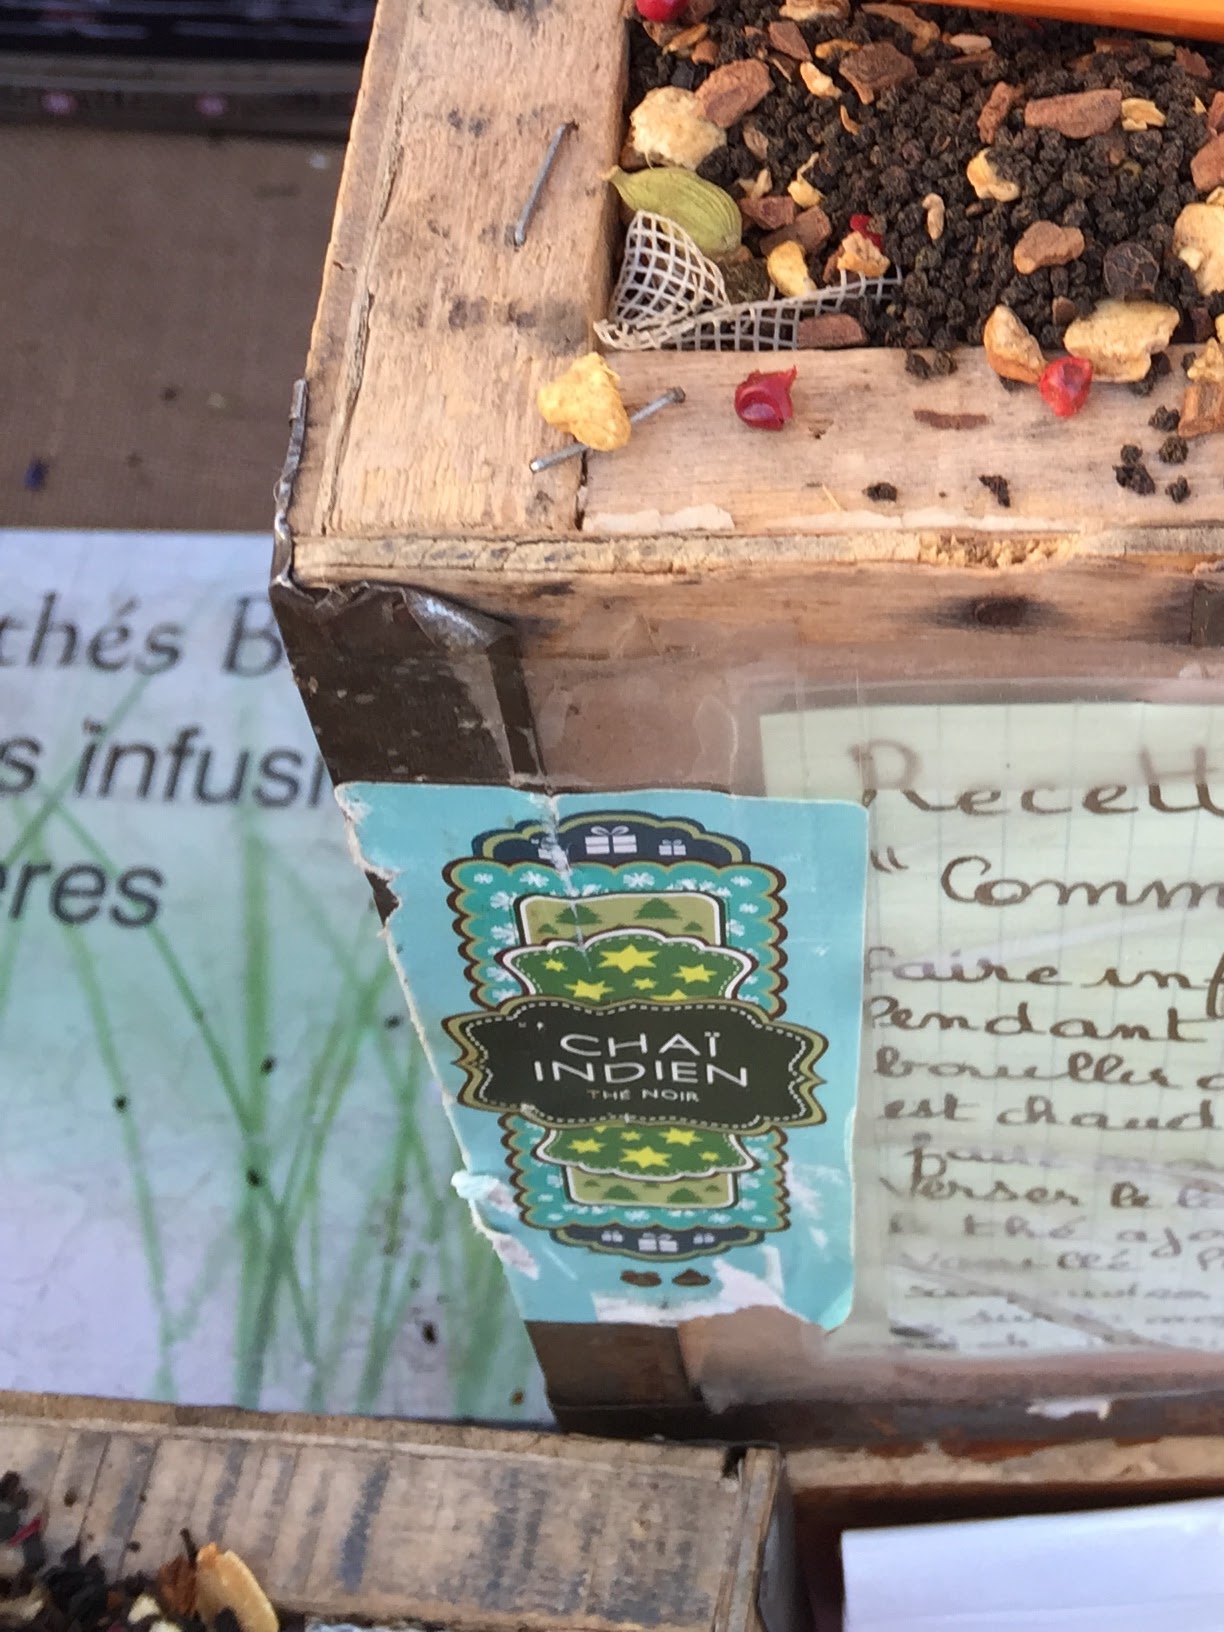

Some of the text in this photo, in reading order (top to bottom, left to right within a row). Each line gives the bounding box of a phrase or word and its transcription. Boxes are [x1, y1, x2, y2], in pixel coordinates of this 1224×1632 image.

[868, 995, 1206, 1044] Pendant
[560, 1031, 720, 1058] CHAÏ
[534, 1060, 748, 1088] INDIEN
[642, 1089, 700, 1102] NOIR
[878, 1093, 980, 1121] est
[997, 1095, 1222, 1131] chaud
